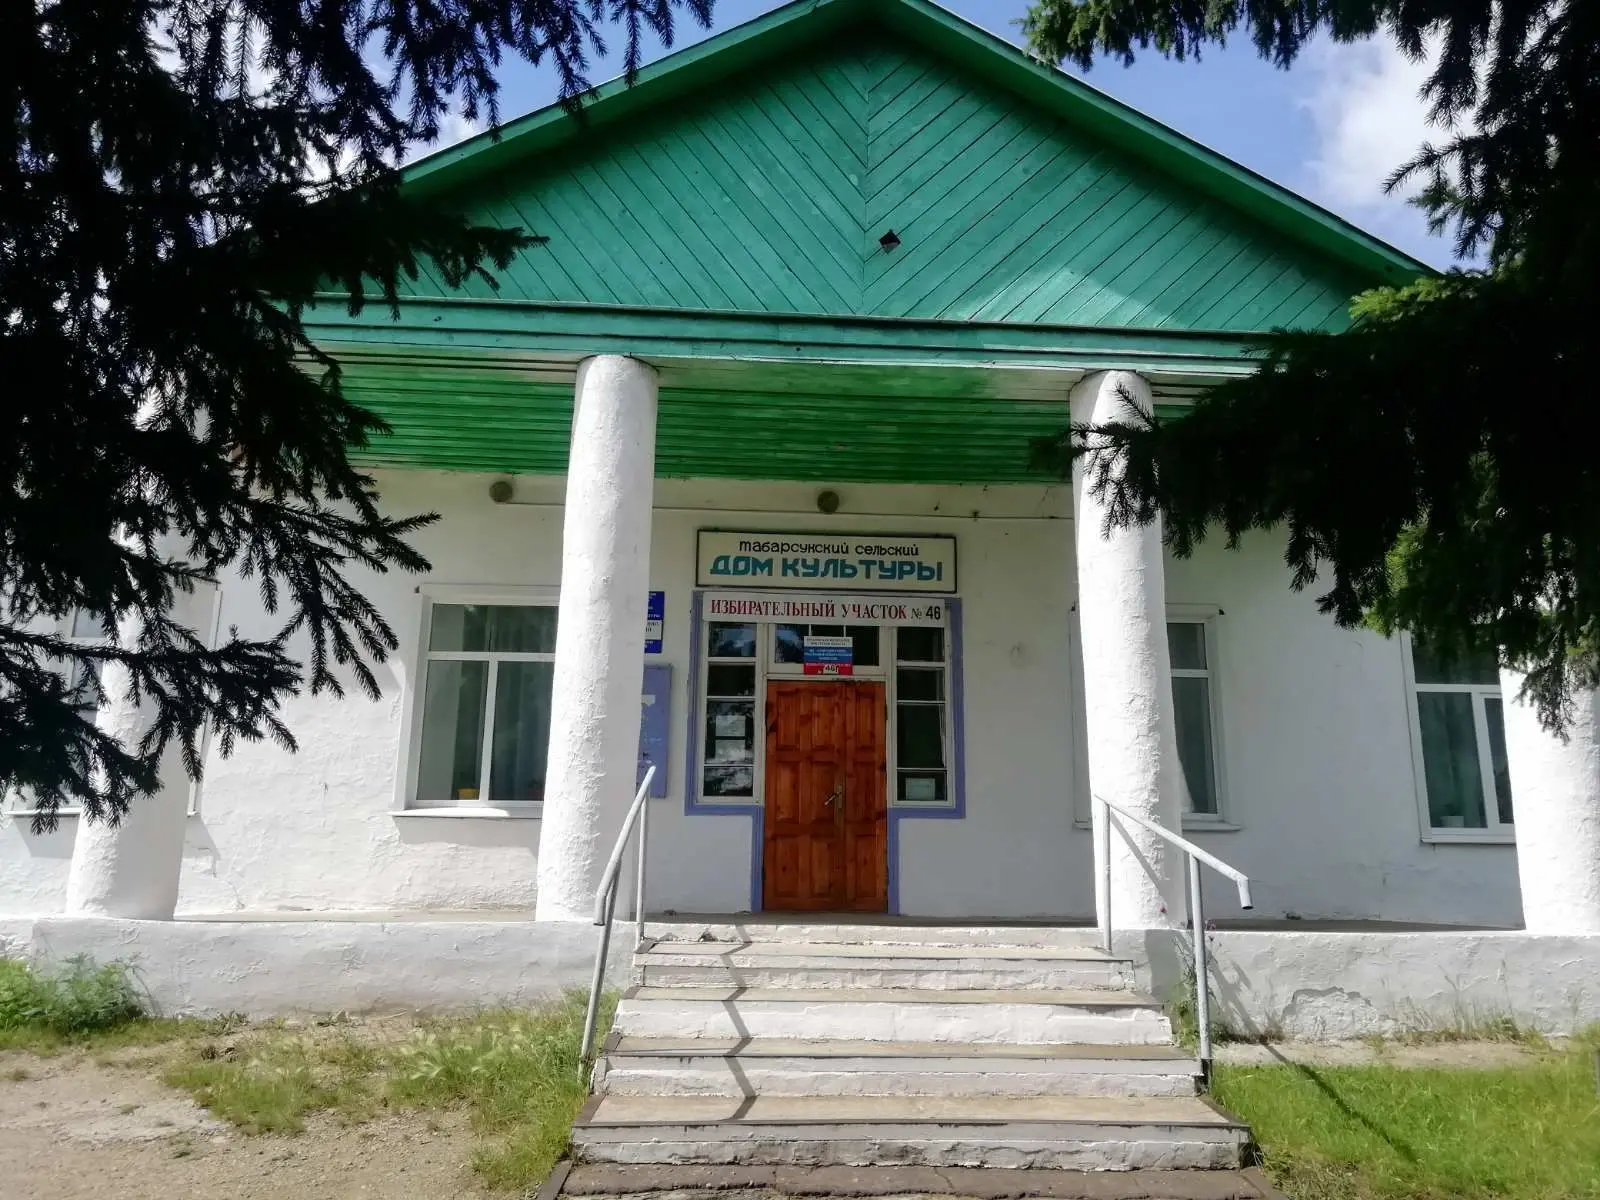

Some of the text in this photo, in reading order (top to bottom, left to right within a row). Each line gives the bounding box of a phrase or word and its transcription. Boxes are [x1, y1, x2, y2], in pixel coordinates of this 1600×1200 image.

[855, 543, 919, 556] сельский
[709, 555, 943, 582] ДОМ КУЛЬТУРЫ
[710, 599, 941, 621] ИЗБИРАТЕЛЬНЫЙ УЧАСТОК № 46
